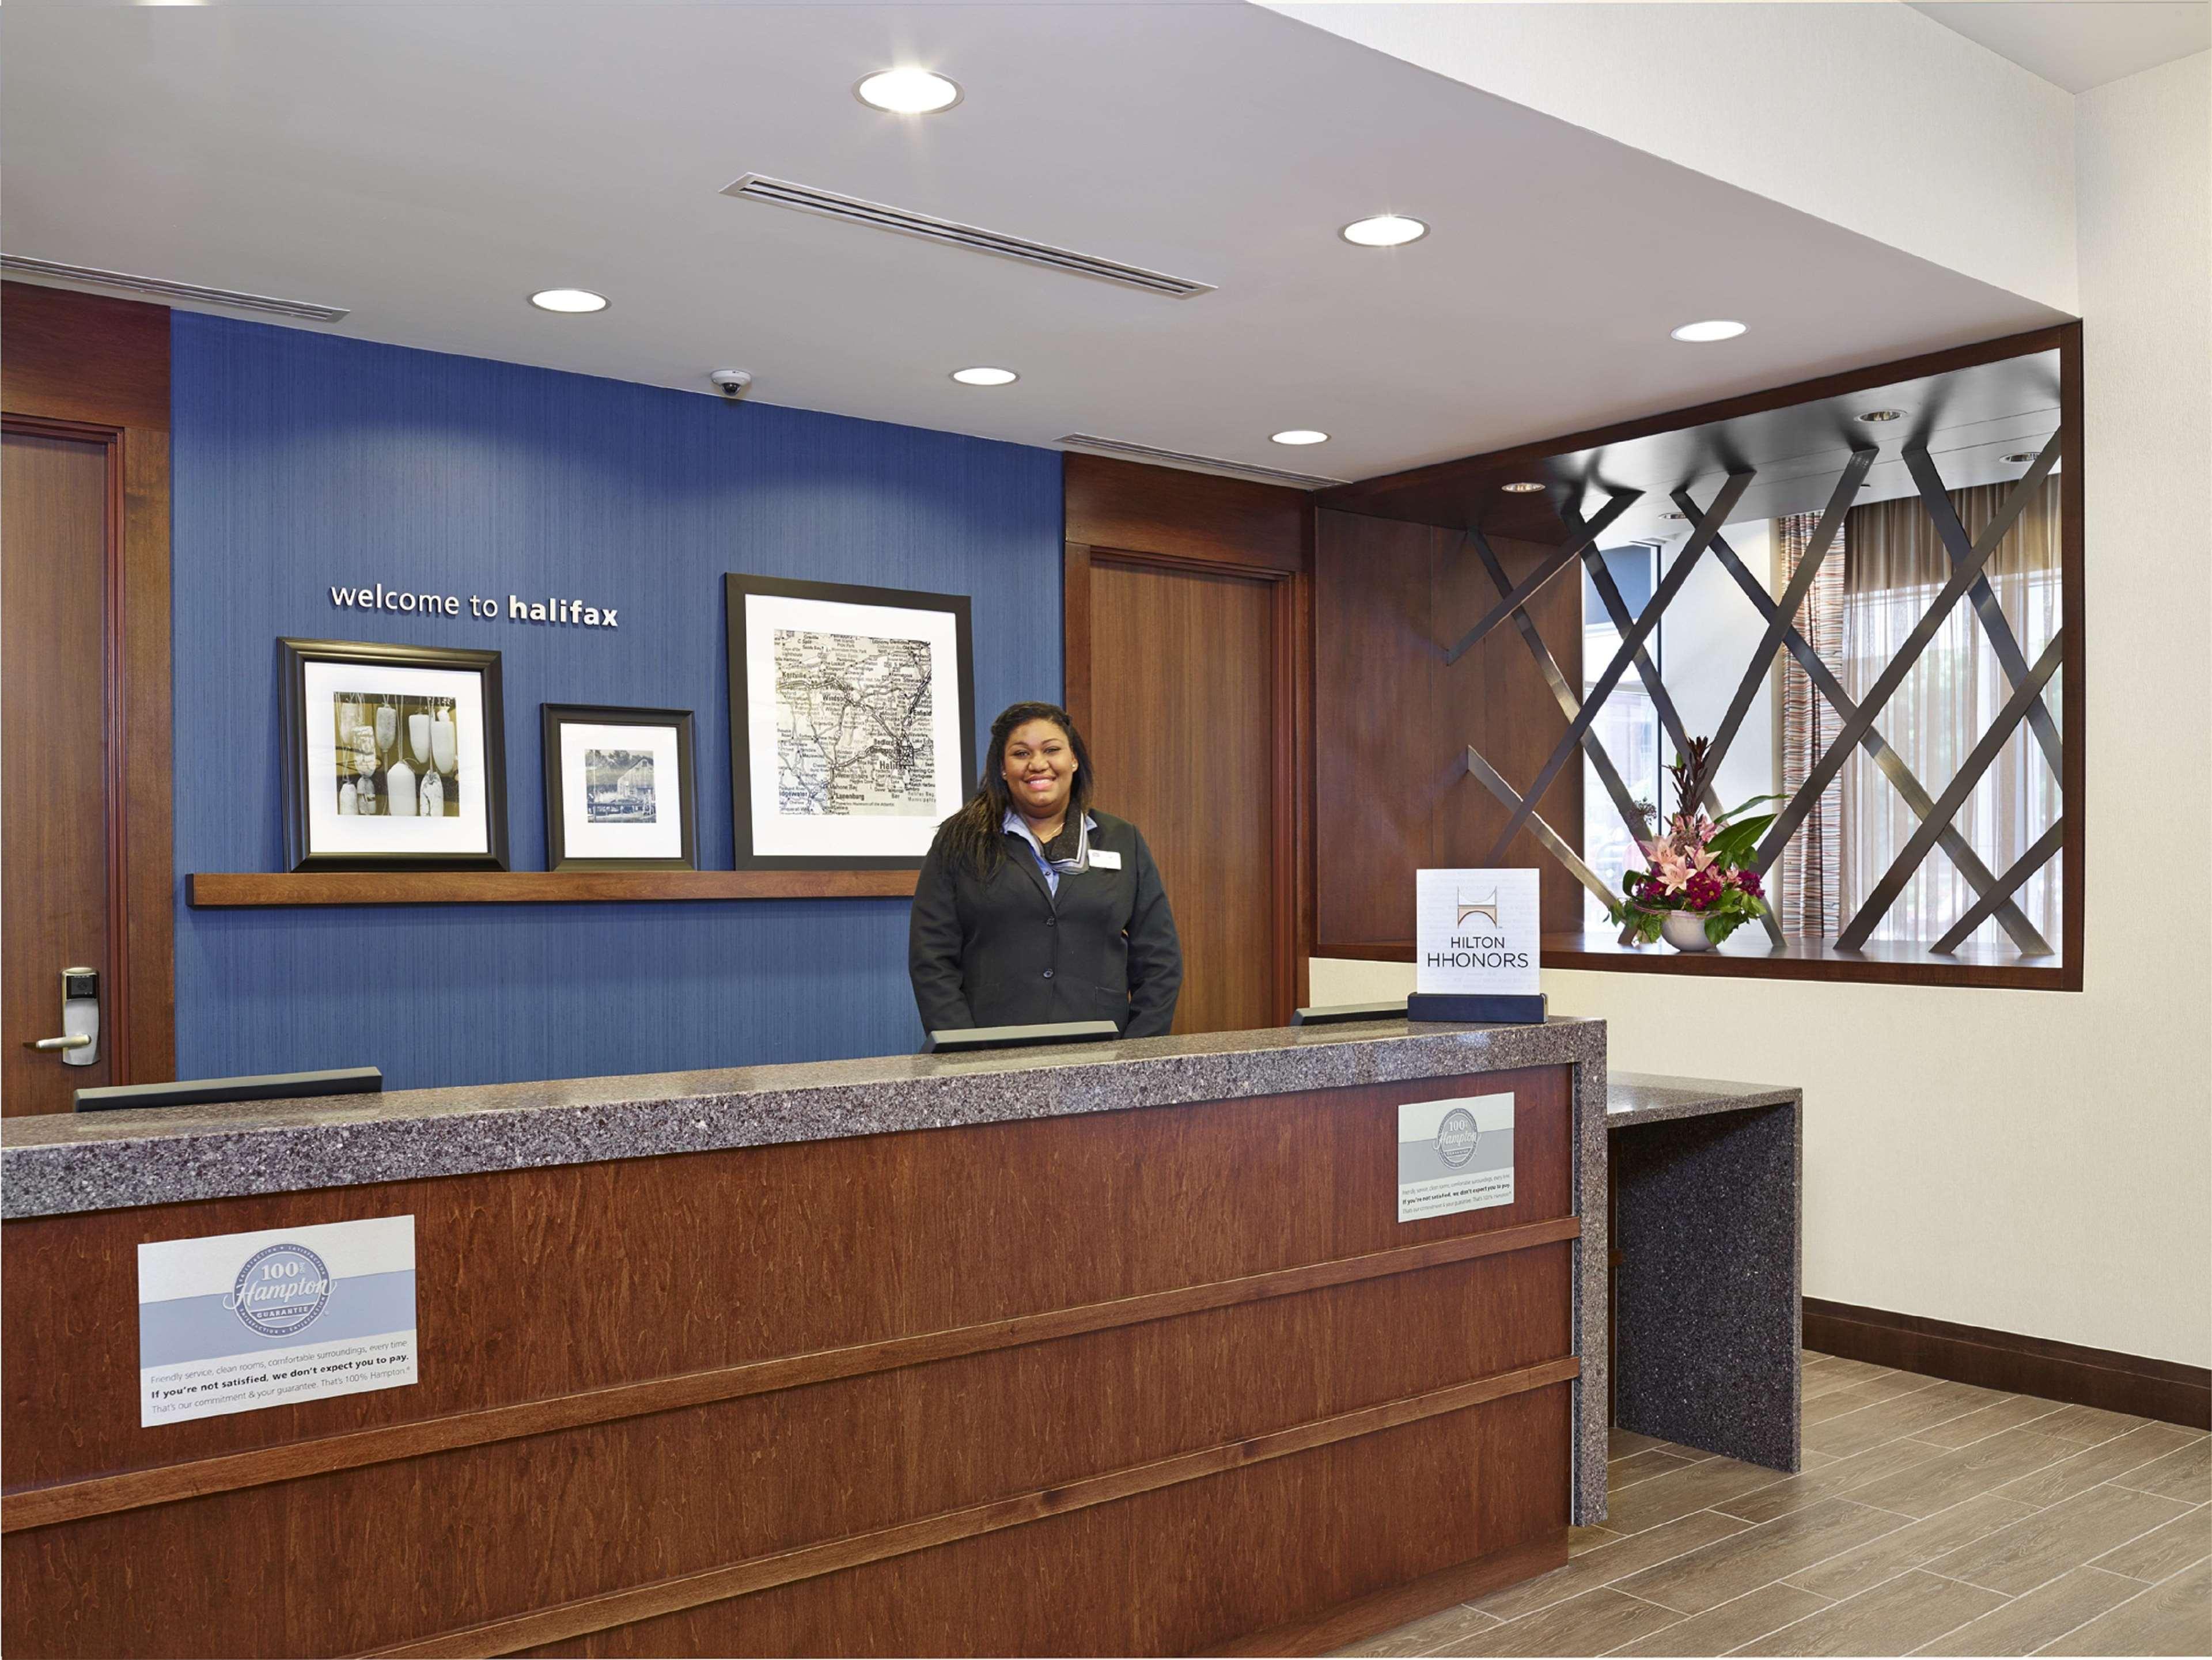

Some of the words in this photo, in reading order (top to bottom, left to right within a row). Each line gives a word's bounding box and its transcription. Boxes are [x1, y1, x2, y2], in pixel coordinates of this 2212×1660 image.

[331, 583, 459, 615] welcome
[470, 595, 498, 617] to
[509, 595, 618, 627] halifax
[1450, 937, 1505, 949] HILTON
[1427, 952, 1529, 968] HHONORS
[1433, 1131, 1482, 1150] Hampton
[223, 1277, 338, 1310] Hampton
[256, 1306, 309, 1318] GUARANTEE
[151, 1373, 183, 1383] Friendly
[185, 1369, 214, 1379] service,
[216, 1366, 237, 1375] clean
[240, 1362, 266, 1371] rooms,
[268, 1353, 315, 1367] comfortable
[317, 1346, 368, 1359] surroundings,
[369, 1343, 389, 1352] every
[151, 1390, 159, 1399] If
[163, 1386, 198, 1399] you're
[201, 1382, 218, 1391] not
[222, 1374, 269, 1388] satisfied,
[272, 1371, 287, 1380] we
[290, 1367, 317, 1377] don't
[320, 1362, 353, 1374] expect
[355, 1359, 374, 1370] you
[376, 1356, 387, 1365] to
[389, 1354, 409, 1365] pay.
[152, 1403, 176, 1414] That's
[178, 1402, 192, 1410] our
[194, 1392, 247, 1407] commitment
[248, 1390, 255, 1399] &
[257, 1389, 275, 1400] your
[277, 1382, 319, 1396] guarantee.
[321, 1377, 343, 1387] That's
[346, 1373, 368, 1383] 100%
